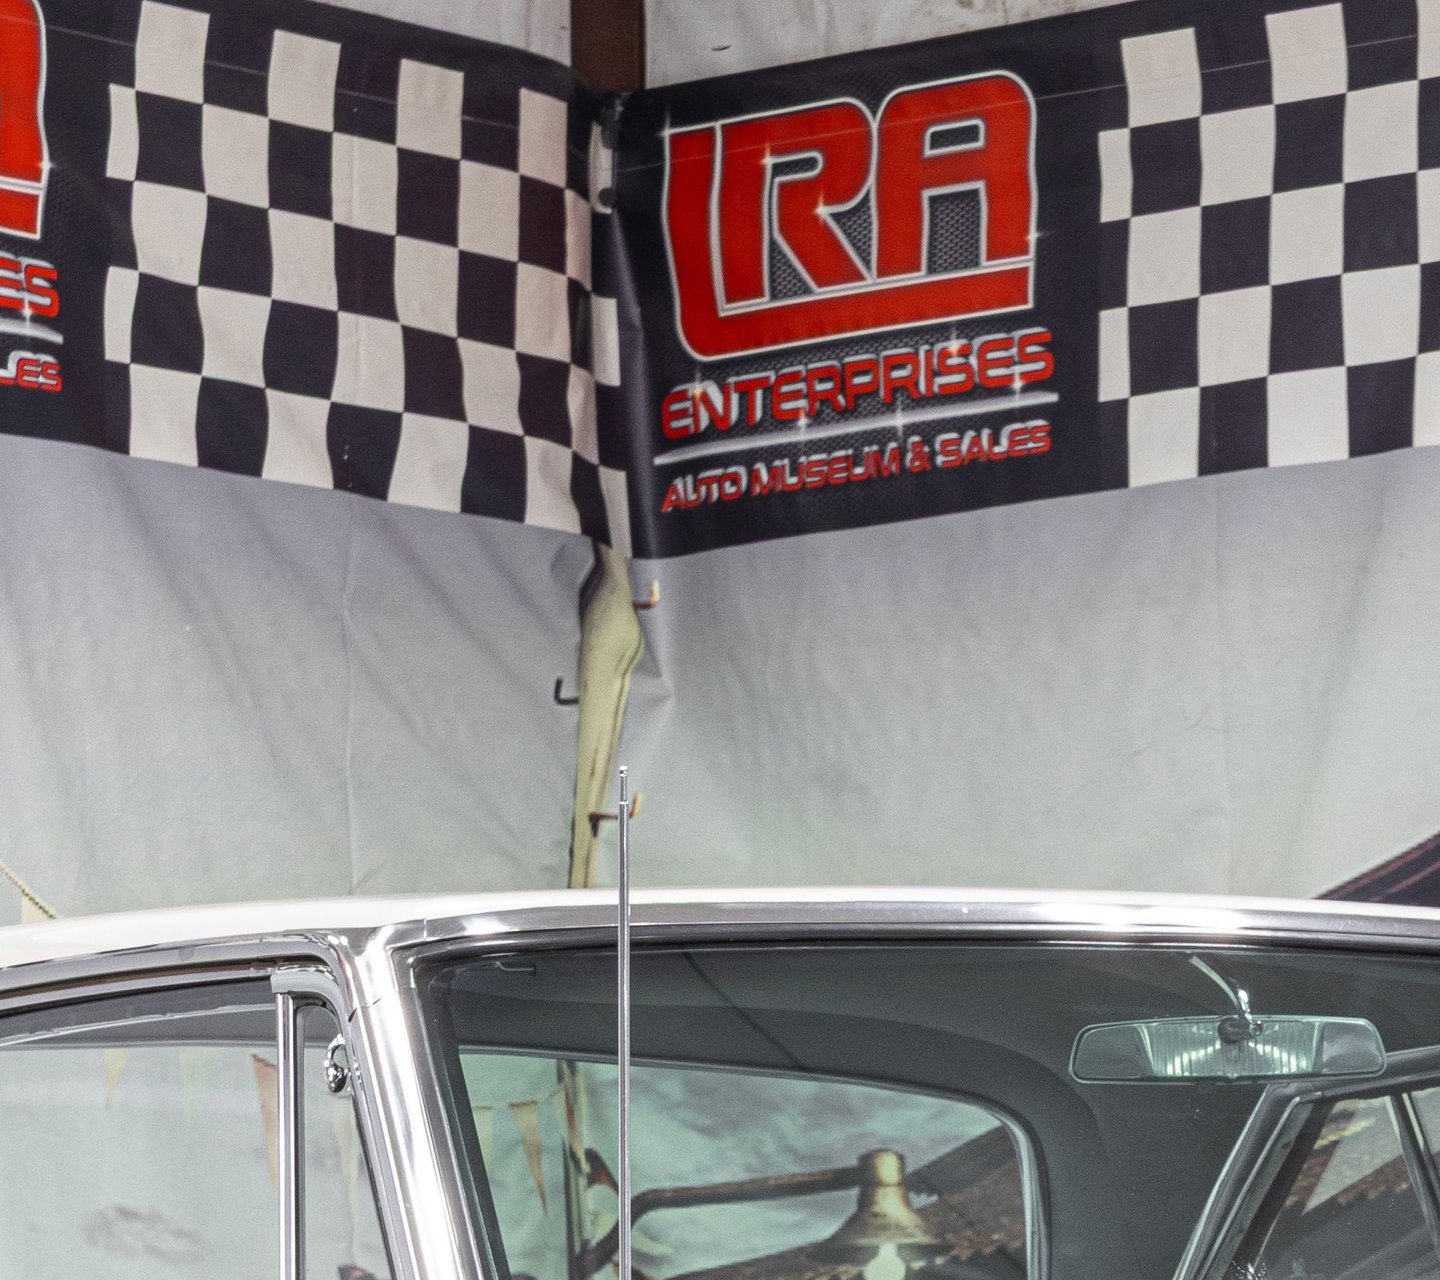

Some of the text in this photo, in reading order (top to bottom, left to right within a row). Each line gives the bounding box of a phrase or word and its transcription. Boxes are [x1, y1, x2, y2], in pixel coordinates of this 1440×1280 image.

[662, 69, 1037, 361] LRA
[660, 327, 1056, 441] ENTERPRISES
[661, 419, 1052, 512] AUTO MUSEUM & SALES
